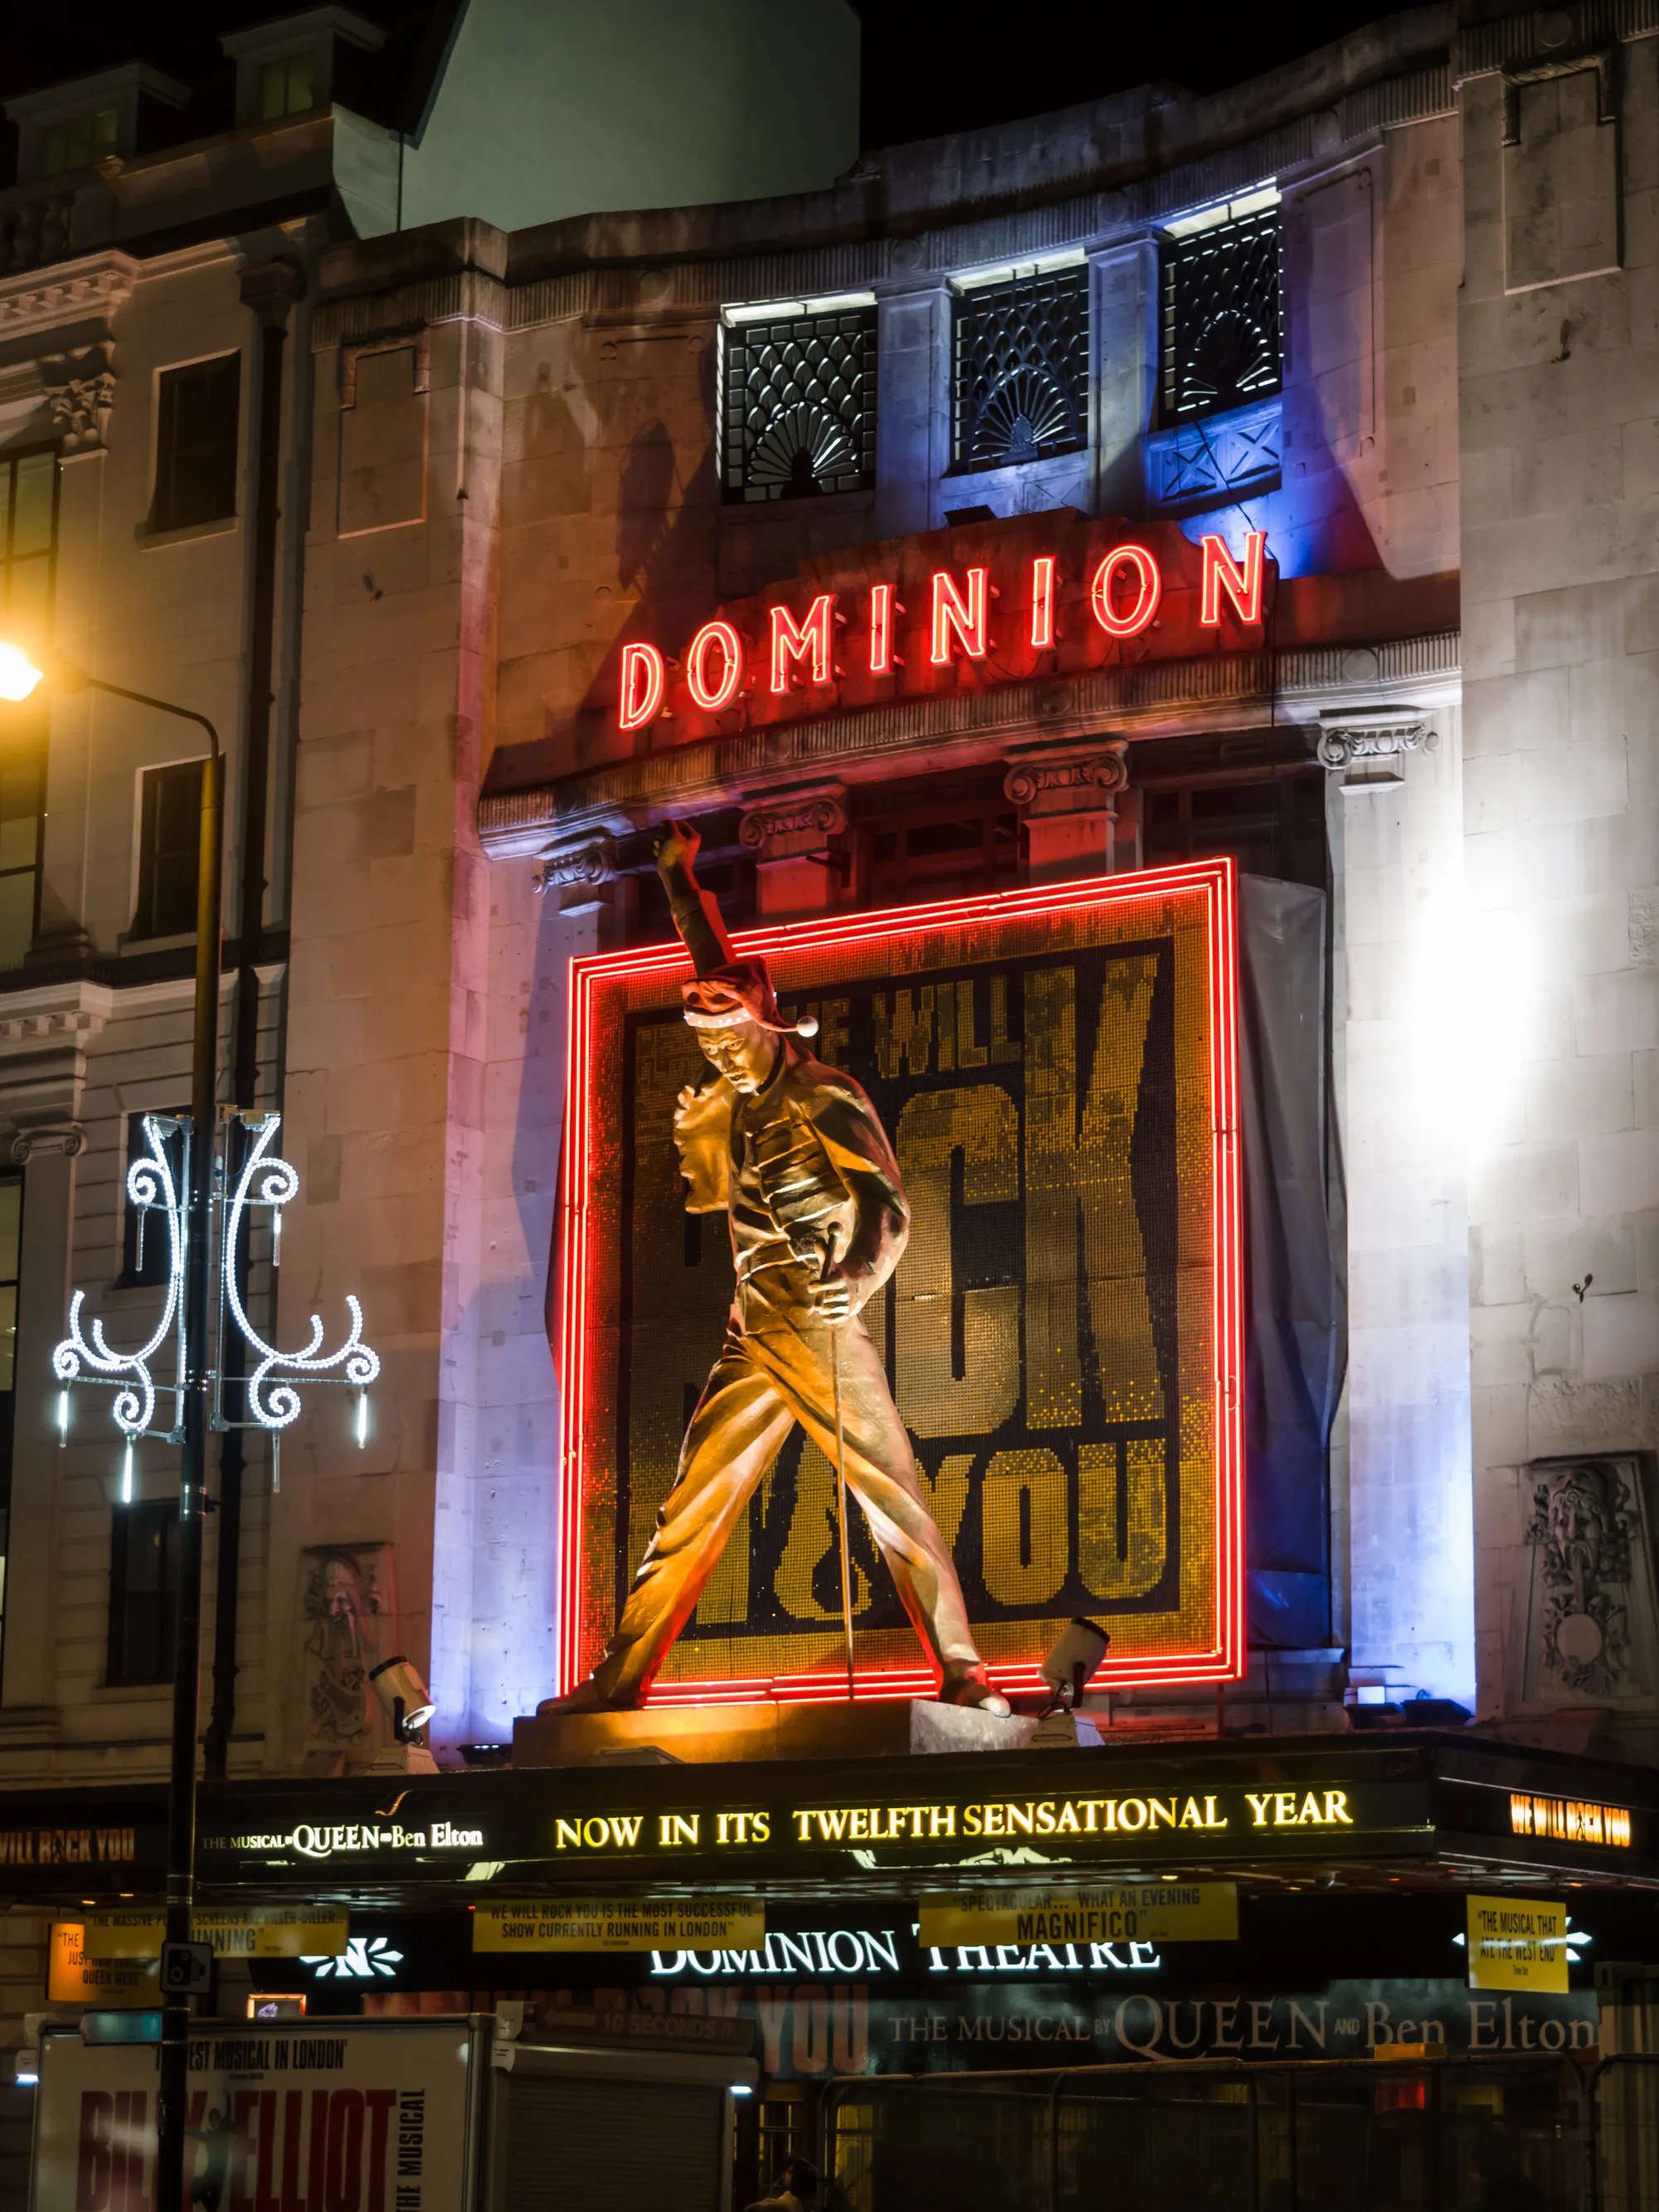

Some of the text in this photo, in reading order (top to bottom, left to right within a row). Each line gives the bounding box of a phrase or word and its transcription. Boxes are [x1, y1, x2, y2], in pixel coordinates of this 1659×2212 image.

[619, 532, 1267, 732] DOMINION
[874, 974, 1022, 1078] WILL
[555, 1790, 1354, 1848] NOW IN ITS TWELFTH SENSATIONAL YEAR
[1511, 1794, 1532, 1834] WE
[1534, 1797, 1566, 1839] WILL
[1604, 1806, 1631, 1847] YOU
[95, 1827, 135, 1862] YOU
[202, 1837, 226, 1850] THE
[231, 1835, 285, 1849] MUSICAL
[293, 1824, 381, 1858] QUEEN
[392, 1825, 426, 1848] Ben
[431, 1821, 484, 1847] Elton
[511, 1904, 539, 1920] WILL
[542, 1904, 572, 1919] ROCK
[577, 1904, 599, 1919] YOU
[603, 1903, 614, 1919] IS
[618, 1903, 638, 1918] THE
[642, 1903, 674, 1918] MOST
[677, 1902, 754, 1918] SUCCESSFUL
[1078, 1890, 1115, 1908] WHAT
[1120, 1889, 1136, 1906] AN
[1142, 1888, 1200, 1906] EVENING
[93, 1913, 109, 1927] THE
[502, 1923, 535, 1938] SHOW
[539, 1922, 604, 1937] CURRENTLY
[607, 1921, 660, 1937] RUNNING
[664, 1921, 676, 1937] IN
[1500, 1912, 1535, 1935] MUSICAL
[1537, 1914, 1557, 1936] THAT
[1498, 1937, 1512, 1960] THE
[1515, 1938, 1536, 1962] WEST
[83, 1969, 111, 1985] QUEEN
[603, 2013, 625, 2035] 10
[628, 2014, 718, 2040] SECONDS
[755, 1984, 869, 2073] YOU
[888, 1993, 1598, 2063] THE MUSICAL BY QUEEN AND Ben Elton
[185, 2040, 211, 2071] EST
[214, 2040, 270, 2070] MUSICAL
[275, 2040, 289, 2069] IN
[397, 2088, 426, 2176] MUSICAL
[230, 2088, 397, 2212] ELLIOT
